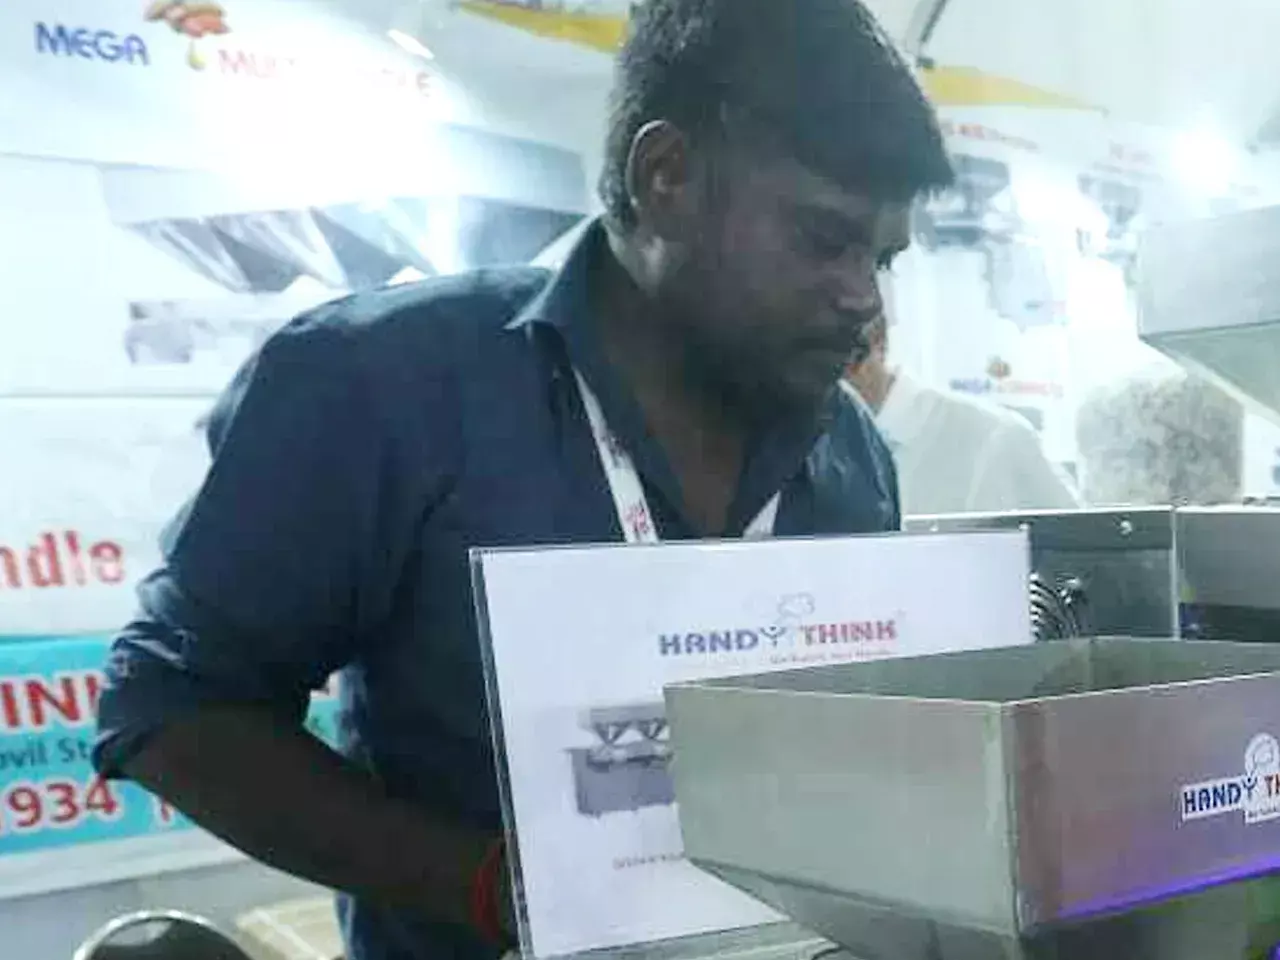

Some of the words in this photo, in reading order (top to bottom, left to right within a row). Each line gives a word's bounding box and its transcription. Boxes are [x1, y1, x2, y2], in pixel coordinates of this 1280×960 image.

[34, 21, 150, 66] MEGA
[659, 625, 787, 656] HANDY
[799, 619, 898, 645] THINK
[1183, 777, 1258, 814] HANDY
